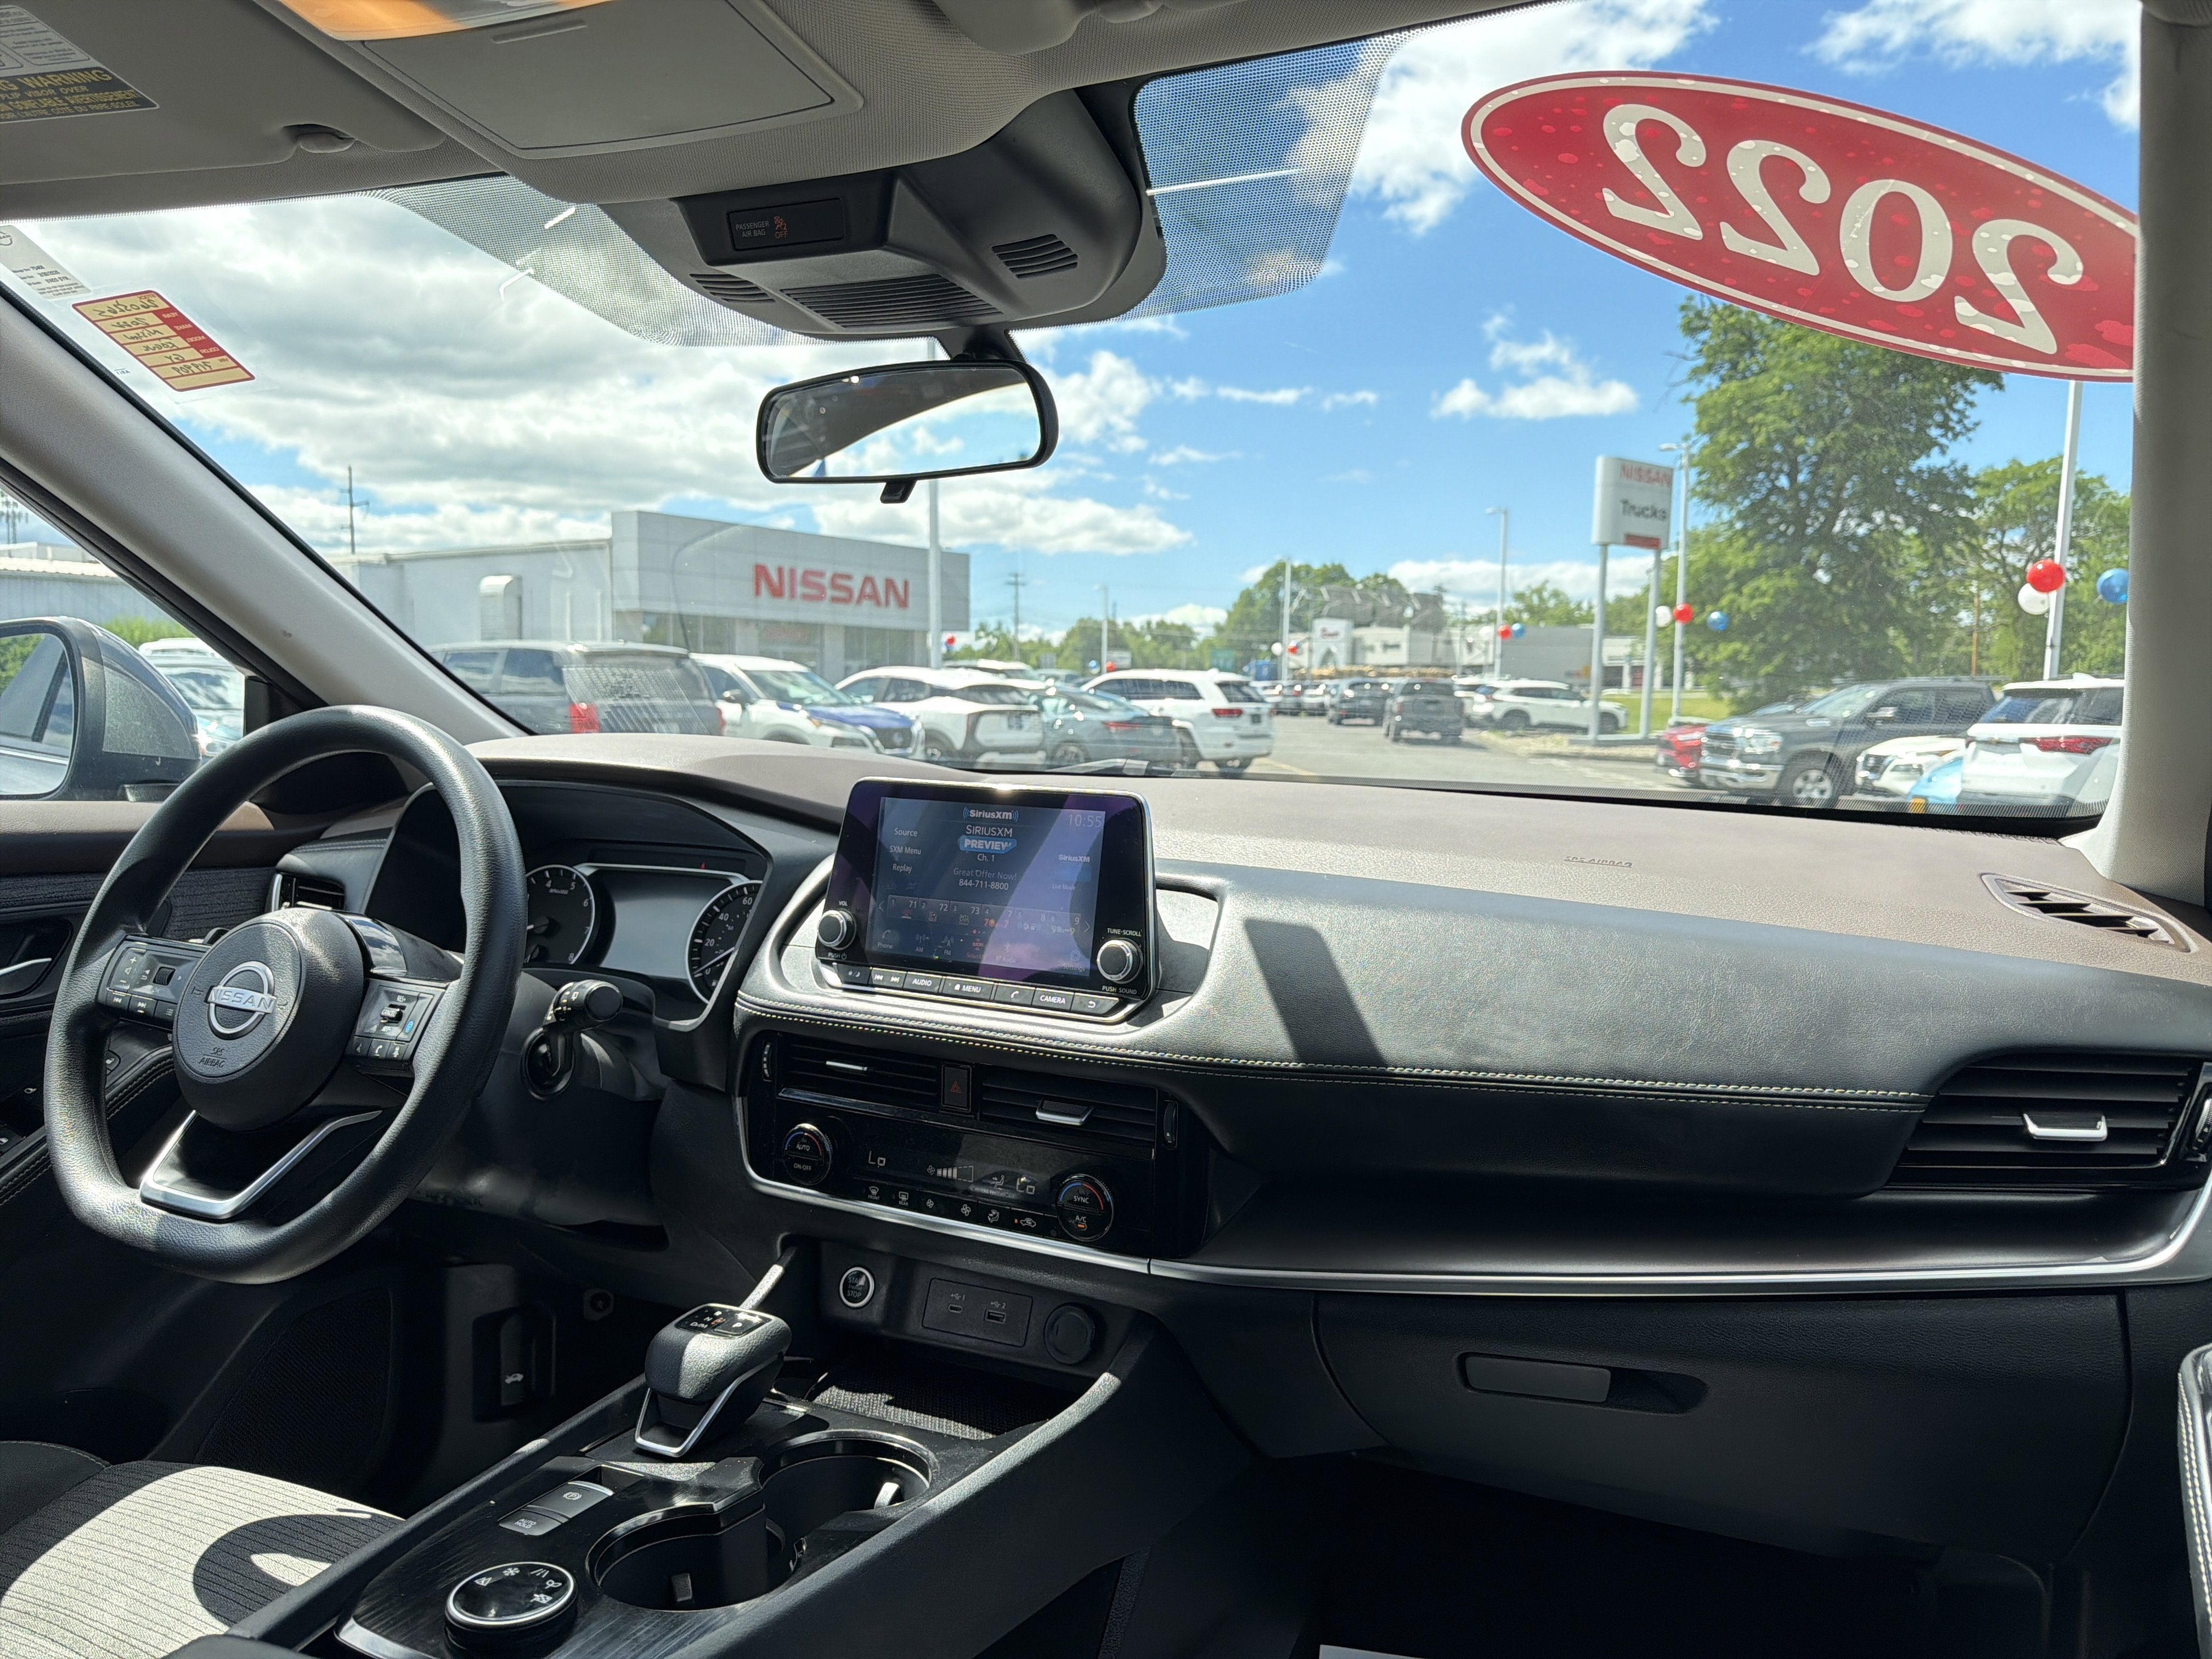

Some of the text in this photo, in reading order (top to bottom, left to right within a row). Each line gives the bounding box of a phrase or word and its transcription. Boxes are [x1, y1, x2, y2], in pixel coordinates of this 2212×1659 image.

[18, 70, 112, 88] WARNING
[25, 89, 56, 98] VISOR
[59, 86, 89, 94] OVER
[736, 221, 770, 230] PASSENGER
[775, 230, 788, 239] OFF
[1621, 464, 1671, 487] NISSAN
[1621, 498, 1667, 522] Trucks
[754, 563, 910, 609] NISSAN
[1069, 814, 1103, 828] 10:55
[894, 827, 918, 837] Source
[966, 825, 1013, 837] SIRIUSXM
[964, 839, 1012, 851] PREVIEW
[890, 845, 922, 855] SXM Menu
[977, 853, 989, 861] Ch.
[1058, 854, 1091, 863] SiriusXM
[893, 863, 912, 874] Replay
[953, 867, 1017, 881] Great Offer Now!
[571, 882, 576, 890] 5
[958, 878, 1009, 890] 844-711-8800
[583, 899, 589, 907] 6
[742, 896, 753, 906] 60
[909, 900, 917, 909] 71
[939, 903, 949, 912] 72
[971, 906, 980, 915] 73
[718, 913, 729, 922] 40
[1041, 913, 1046, 922] 8
[1075, 917, 1080, 925] 9
[704, 938, 715, 947] 20
[568, 953, 574, 961] 8
[912, 978, 932, 986] AUDIO
[962, 985, 981, 993] MENU
[1119, 987, 1138, 995] SOUND
[210, 988, 273, 1011] NISSAN
[1040, 995, 1066, 1005] CAMERA
[199, 1057, 226, 1068] AIRBAG
[796, 1143, 810, 1151] AUTO
[1073, 1195, 1089, 1204] SYNC
[1075, 1215, 1087, 1223] A/C
